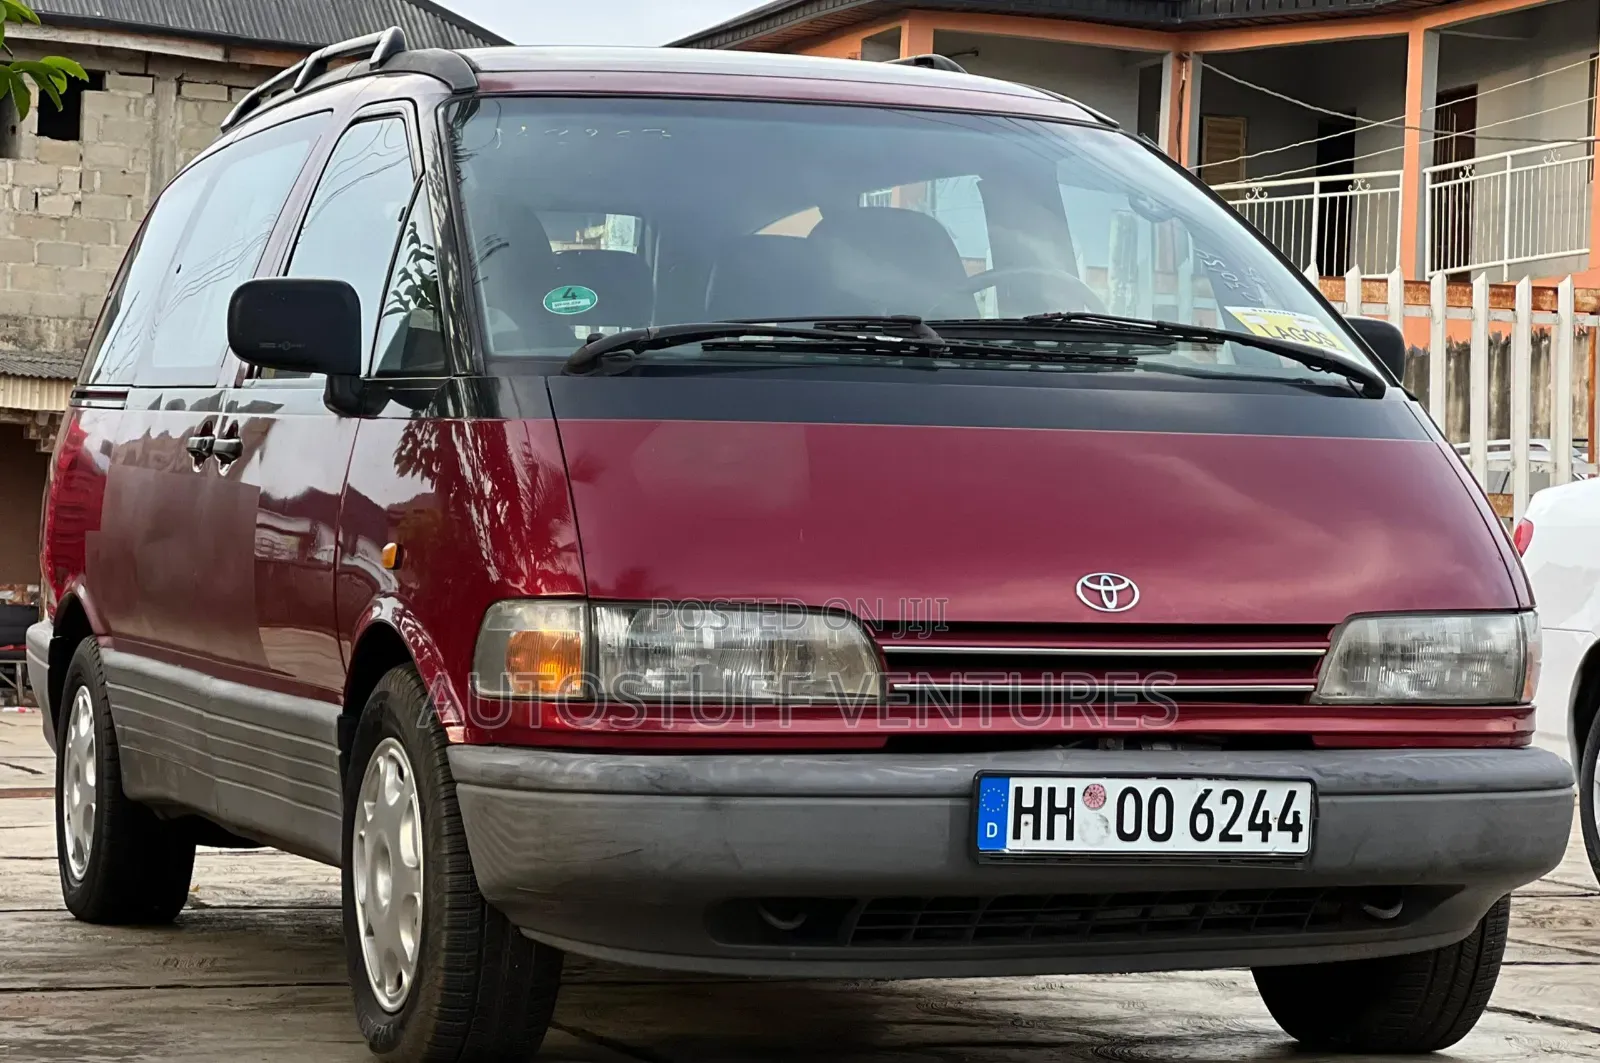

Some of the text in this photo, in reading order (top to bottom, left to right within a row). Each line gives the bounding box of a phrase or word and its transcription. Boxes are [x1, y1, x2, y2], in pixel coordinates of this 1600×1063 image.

[562, 287, 577, 300] 4
[1259, 324, 1337, 348] LAGOS
[1012, 786, 1076, 841] HH
[1189, 788, 1303, 843] 6244
[985, 822, 999, 839] D
